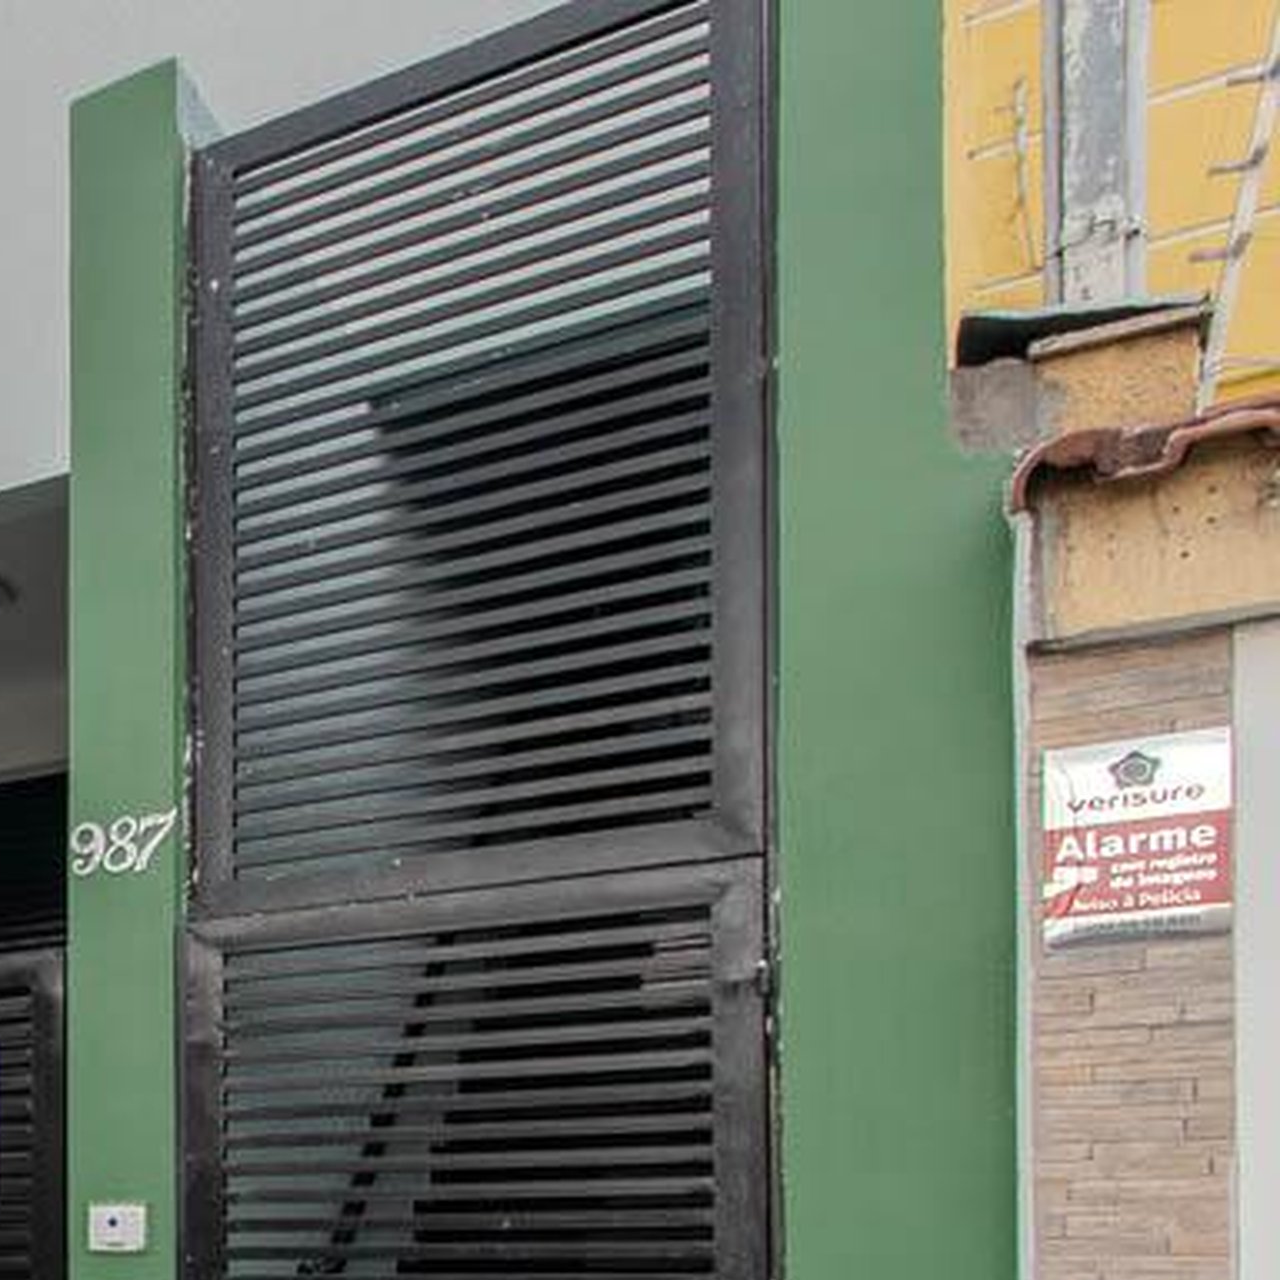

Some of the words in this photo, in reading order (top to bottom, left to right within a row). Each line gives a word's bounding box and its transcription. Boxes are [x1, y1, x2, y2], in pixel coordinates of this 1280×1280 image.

[1067, 784, 1205, 814] verisure
[71, 805, 178, 876] 987
[1055, 823, 1218, 863] Alarme
